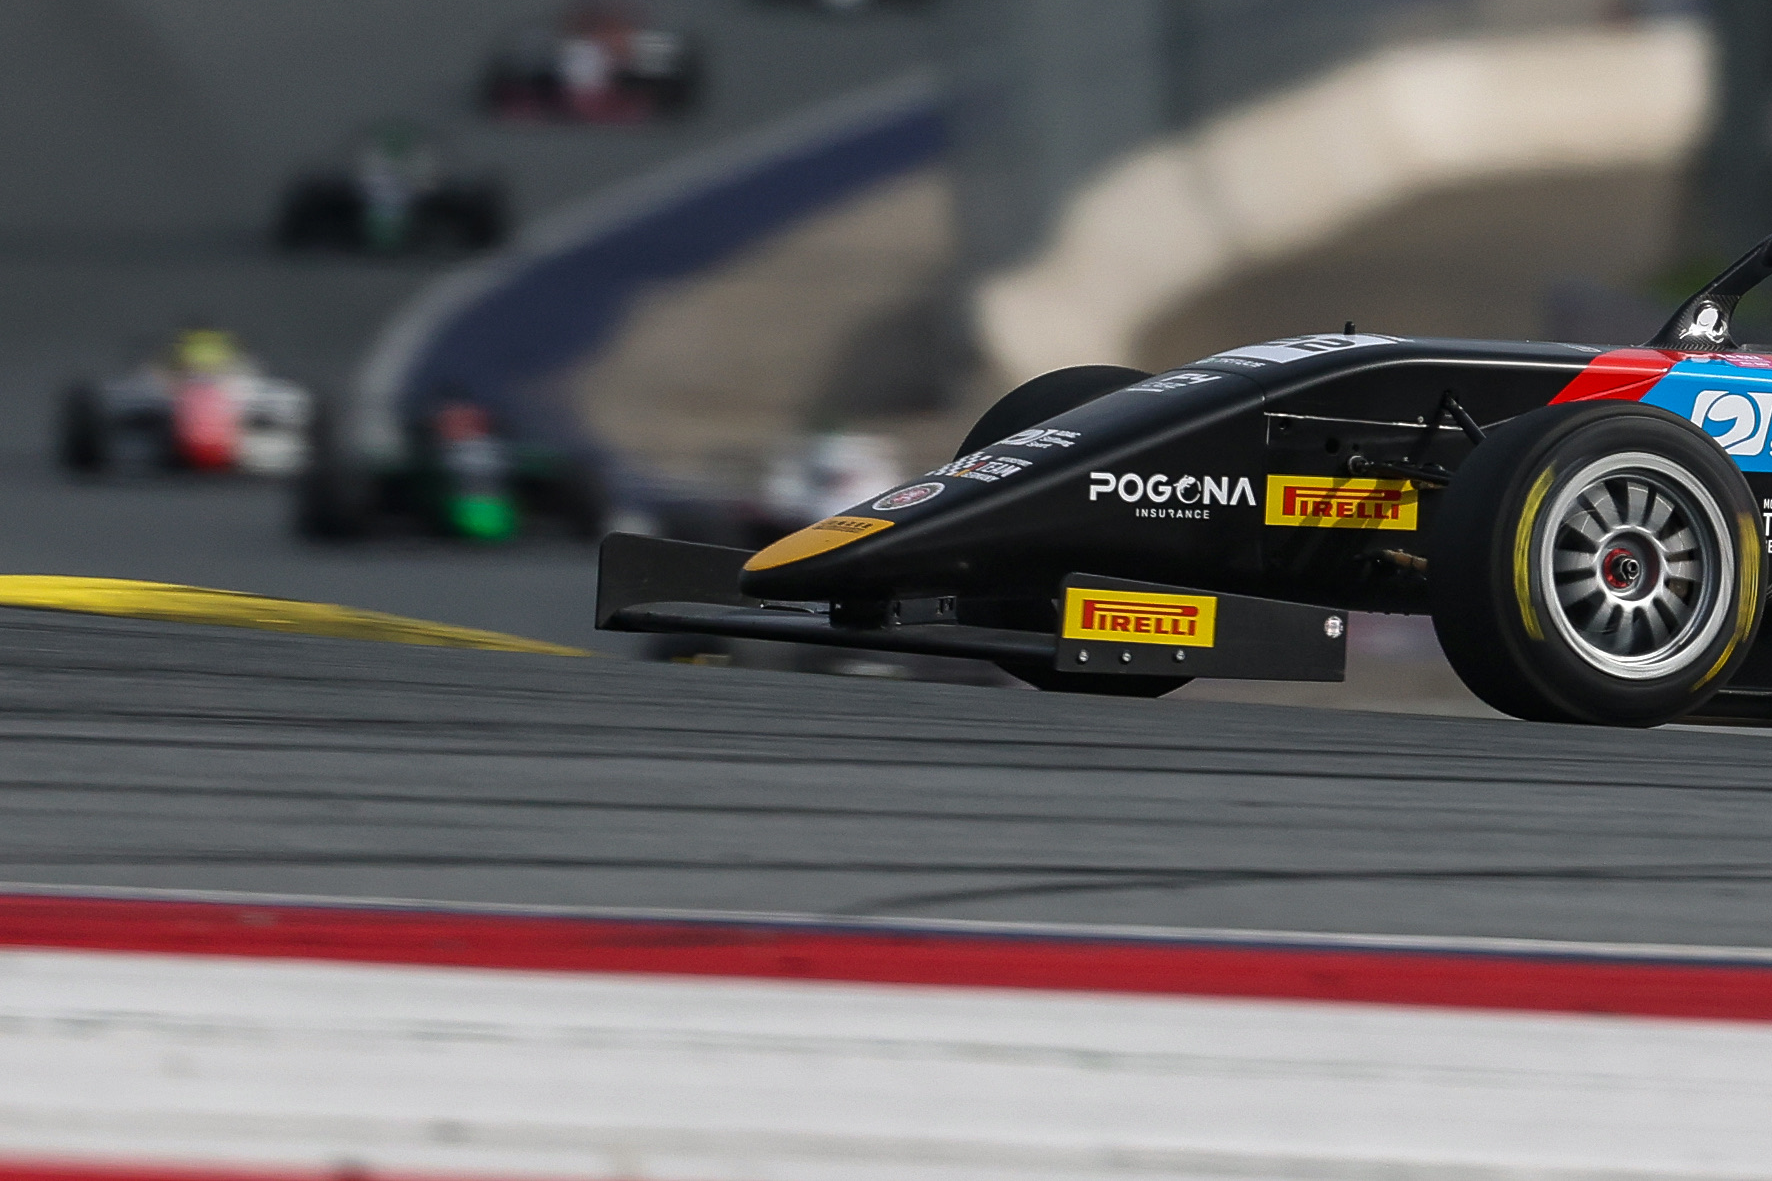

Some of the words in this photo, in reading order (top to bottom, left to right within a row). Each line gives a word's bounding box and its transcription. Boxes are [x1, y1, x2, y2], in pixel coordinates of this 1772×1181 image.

[1089, 471, 1257, 506] POGONA
[1282, 485, 1402, 520] PIRELLI
[1135, 508, 1211, 519] INSURANCE
[1081, 598, 1199, 637] PIRELLI
